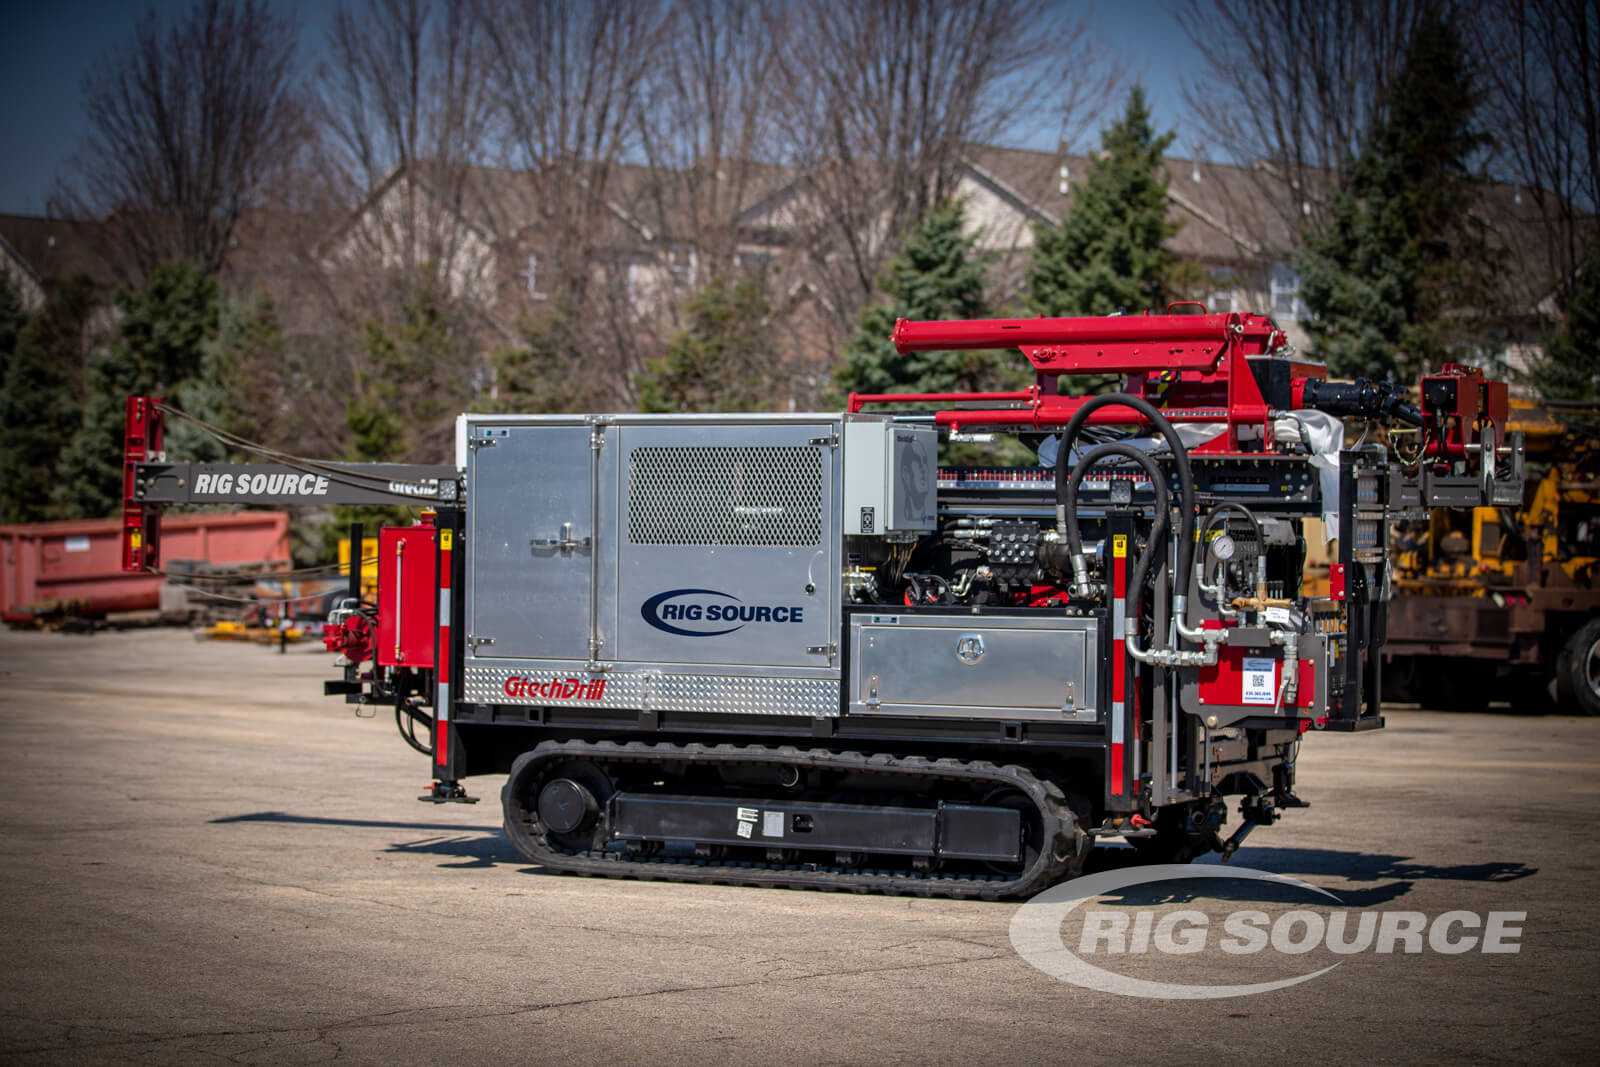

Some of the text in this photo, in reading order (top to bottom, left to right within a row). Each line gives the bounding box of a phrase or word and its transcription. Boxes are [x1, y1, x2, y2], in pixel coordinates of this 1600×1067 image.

[194, 474, 329, 495] RIG SOURCE
[662, 604, 803, 622] RIG SOURCE
[504, 677, 606, 700] GtechDrill
